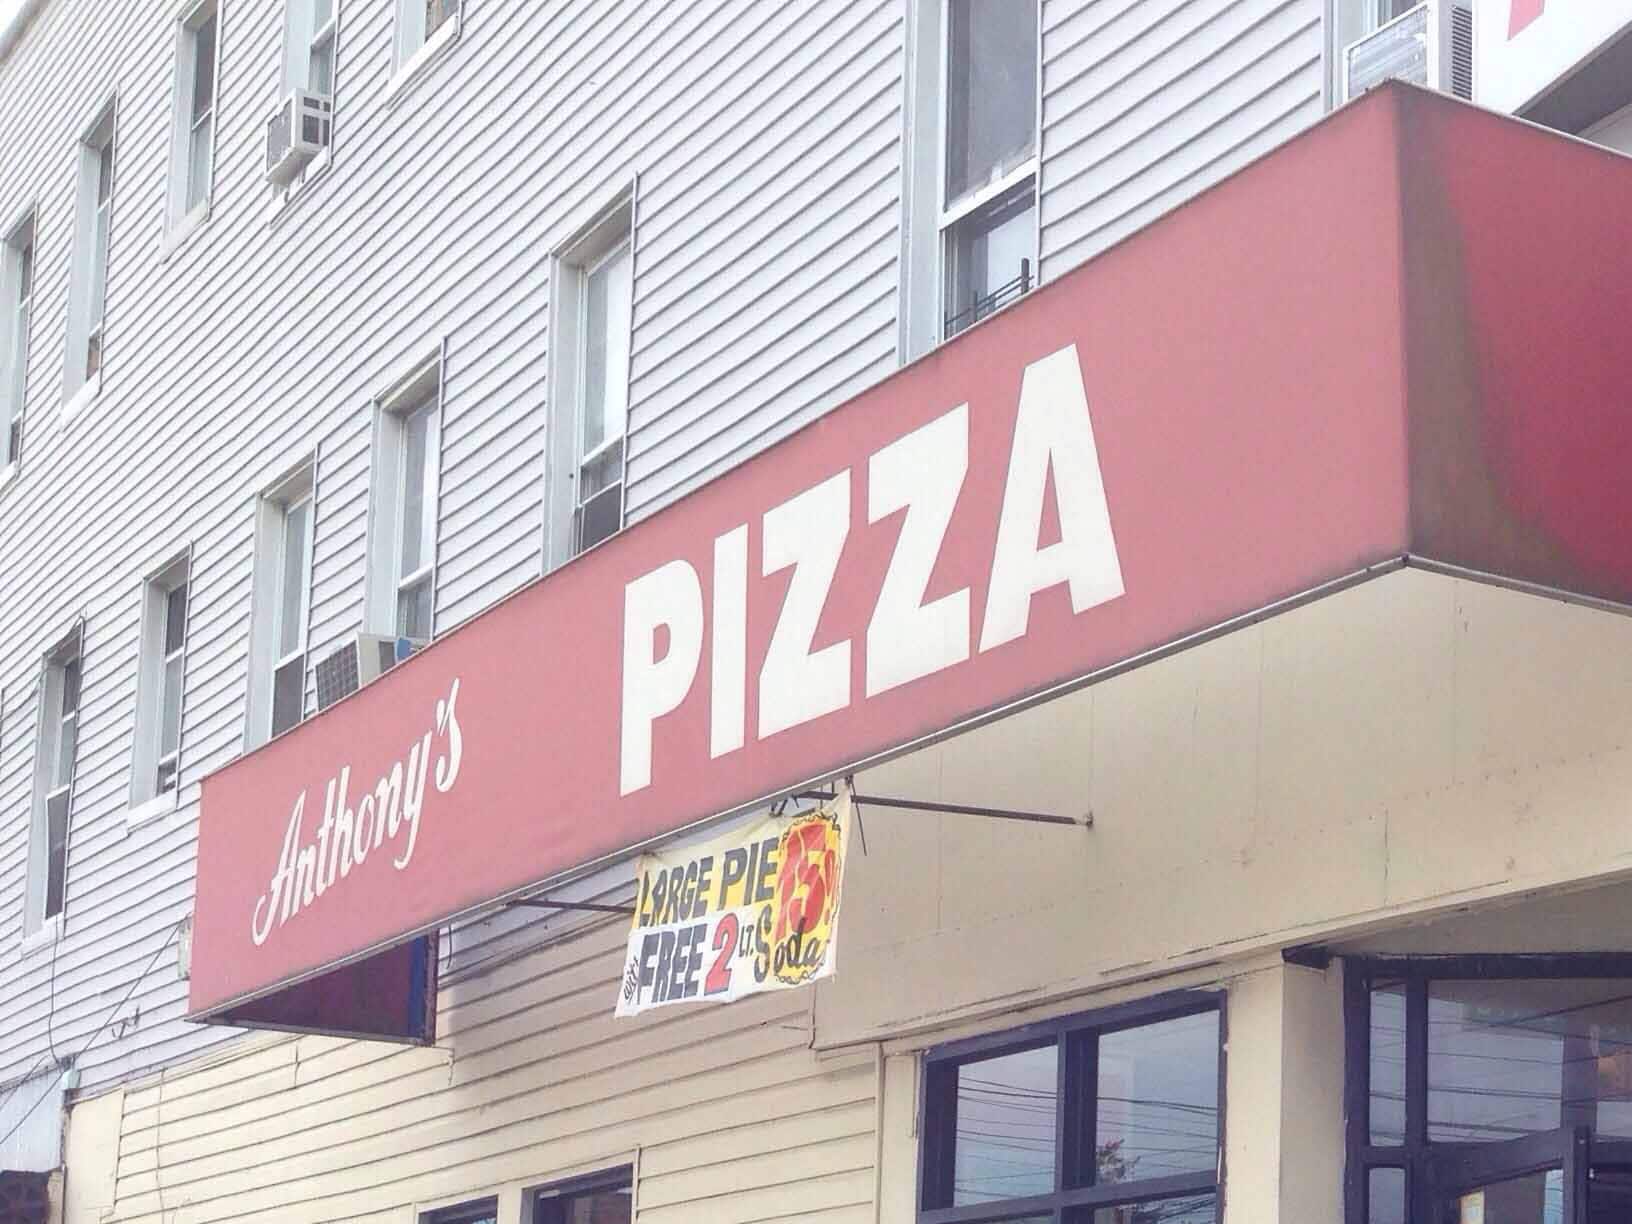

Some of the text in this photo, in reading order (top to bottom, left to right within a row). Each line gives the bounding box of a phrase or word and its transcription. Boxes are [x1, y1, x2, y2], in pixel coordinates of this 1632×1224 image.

[251, 343, 1127, 946] Anthony's PIZZA
[639, 837, 779, 927] LARGE PIE
[637, 923, 707, 1004] FREE
[704, 912, 739, 996] 2
[753, 904, 824, 983] Soda
